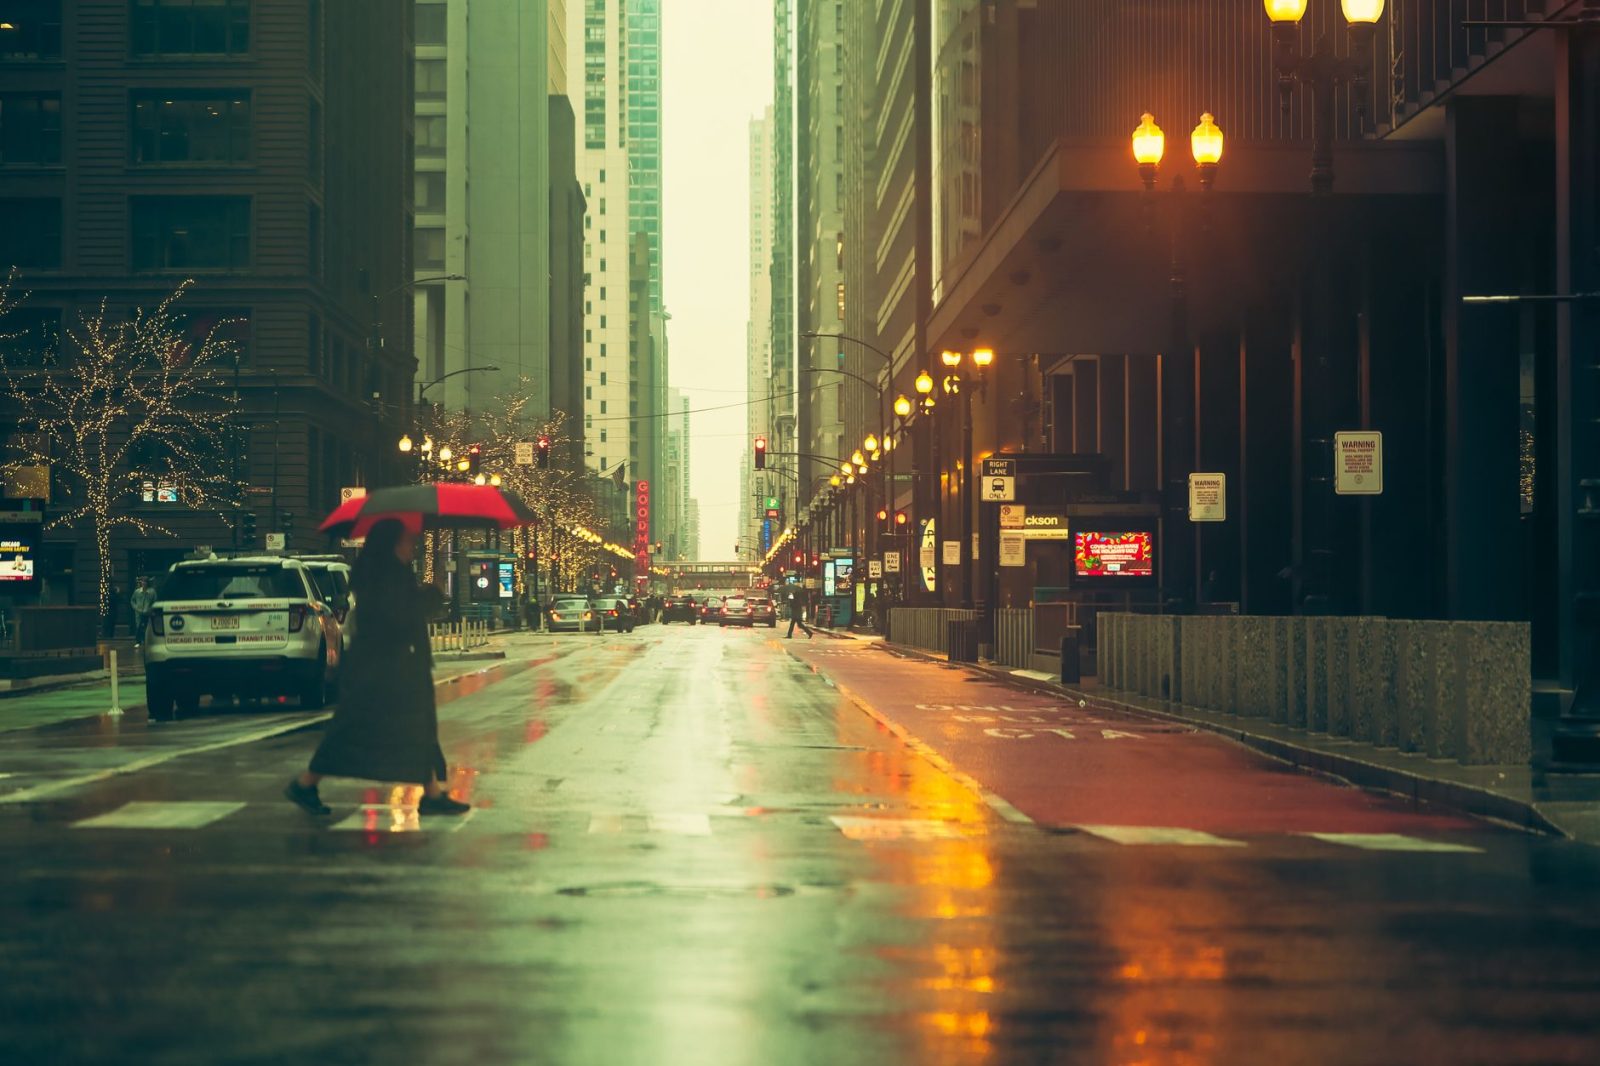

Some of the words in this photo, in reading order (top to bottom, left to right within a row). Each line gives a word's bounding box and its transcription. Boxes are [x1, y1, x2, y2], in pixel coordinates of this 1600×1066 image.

[1342, 440, 1376, 448] WARNING
[1025, 516, 1058, 525] ckson
[927, 530, 936, 574] PAK
[984, 728, 1145, 739] CTA
